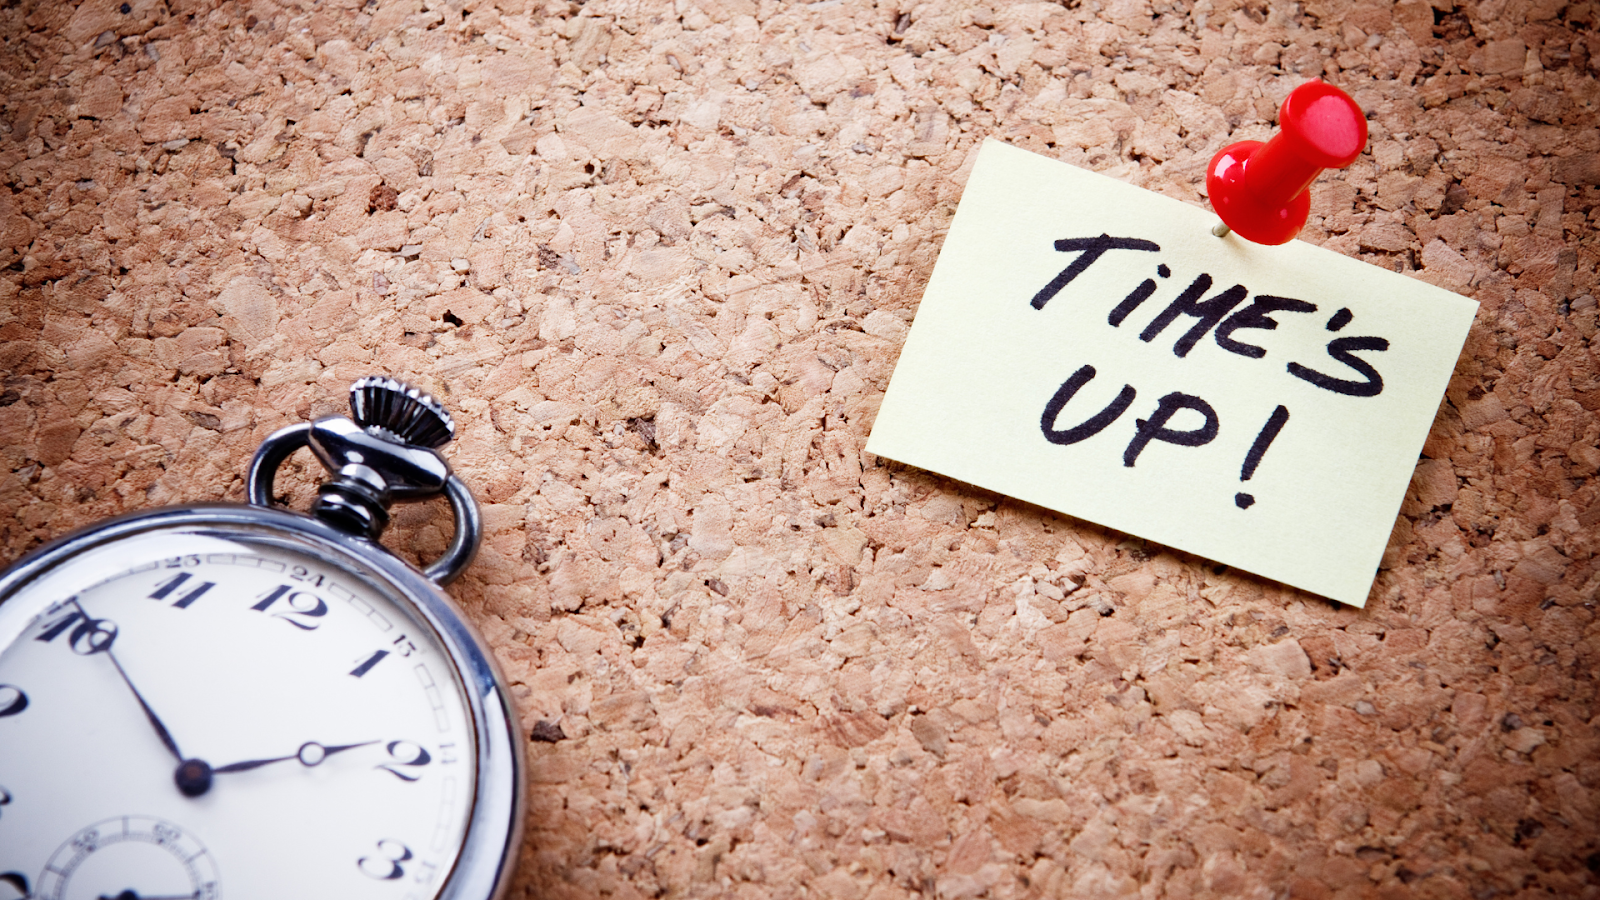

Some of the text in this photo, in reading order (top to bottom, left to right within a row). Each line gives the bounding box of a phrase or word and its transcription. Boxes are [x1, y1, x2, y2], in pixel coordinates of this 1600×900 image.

[1040, 365, 1289, 509] UP!
[164, 553, 201, 569] 23
[289, 564, 325, 588] 24
[147, 571, 217, 610] 11
[250, 584, 328, 631] 12
[348, 649, 391, 679] 1
[393, 634, 416, 658] 13
[371, 739, 431, 783] 2
[357, 837, 413, 880] 3
